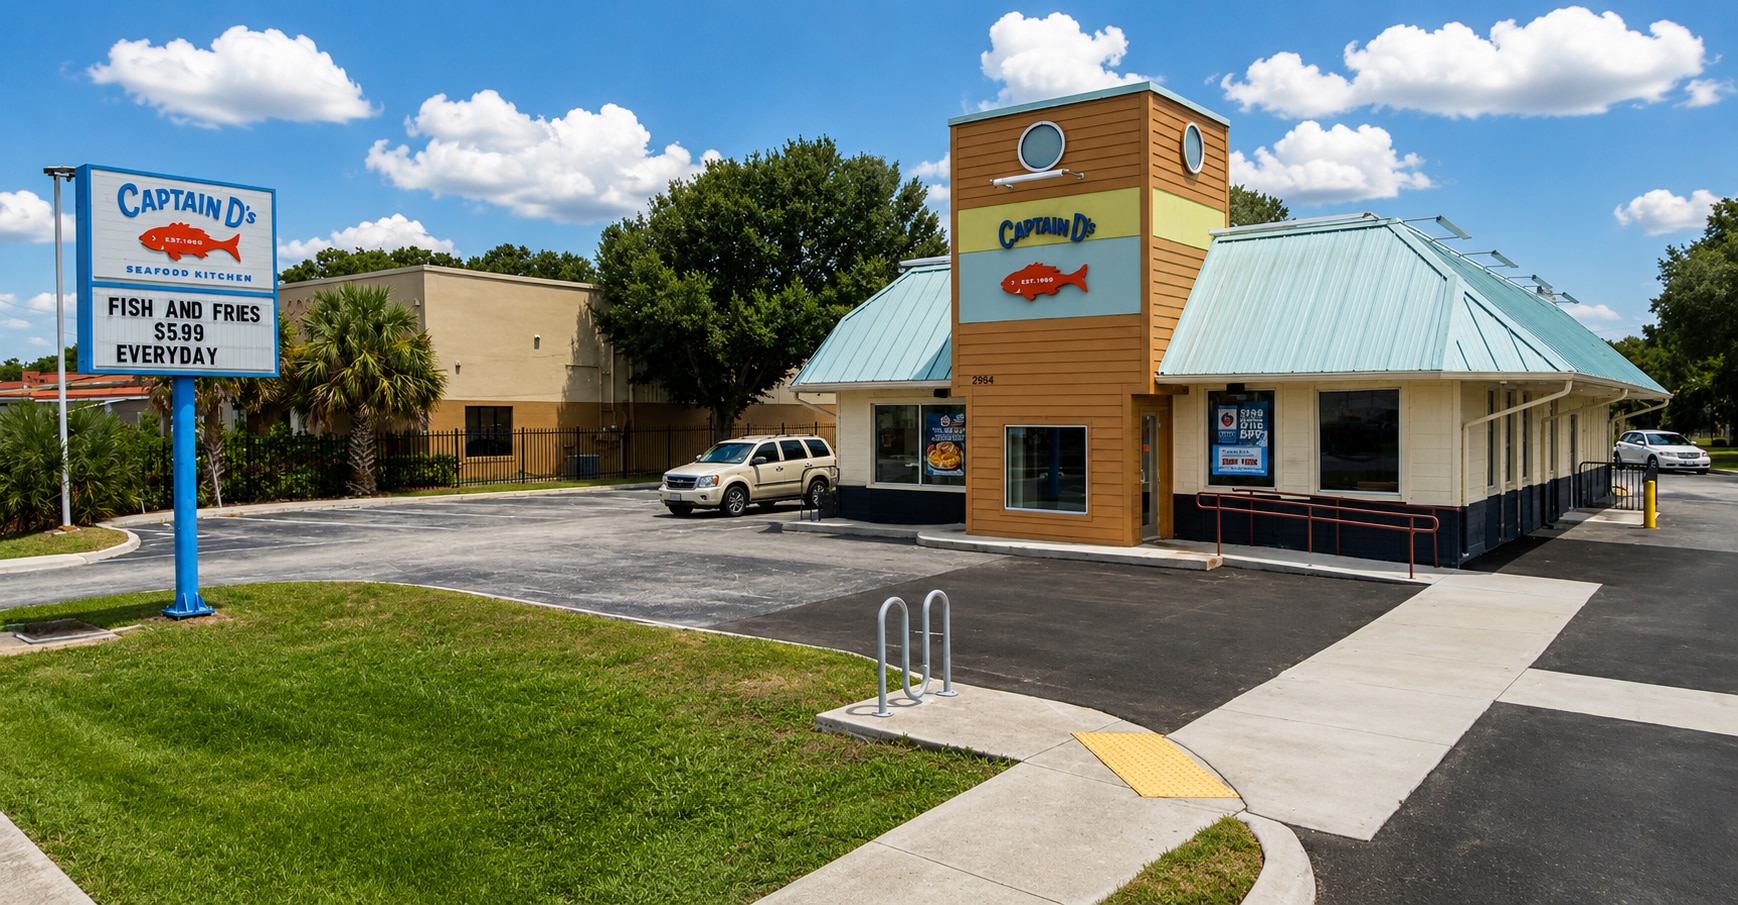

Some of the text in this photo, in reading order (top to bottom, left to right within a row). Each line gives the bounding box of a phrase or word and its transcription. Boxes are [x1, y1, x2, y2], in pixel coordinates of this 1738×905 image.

[117, 183, 222, 220] CAPTAIN
[999, 216, 1069, 249] CAPTAIN
[194, 271, 252, 282] KITCHEN
[108, 297, 261, 323] FISH AND FRIES
[154, 322, 204, 342] $5.99
[116, 344, 218, 366] EVERYDAY
